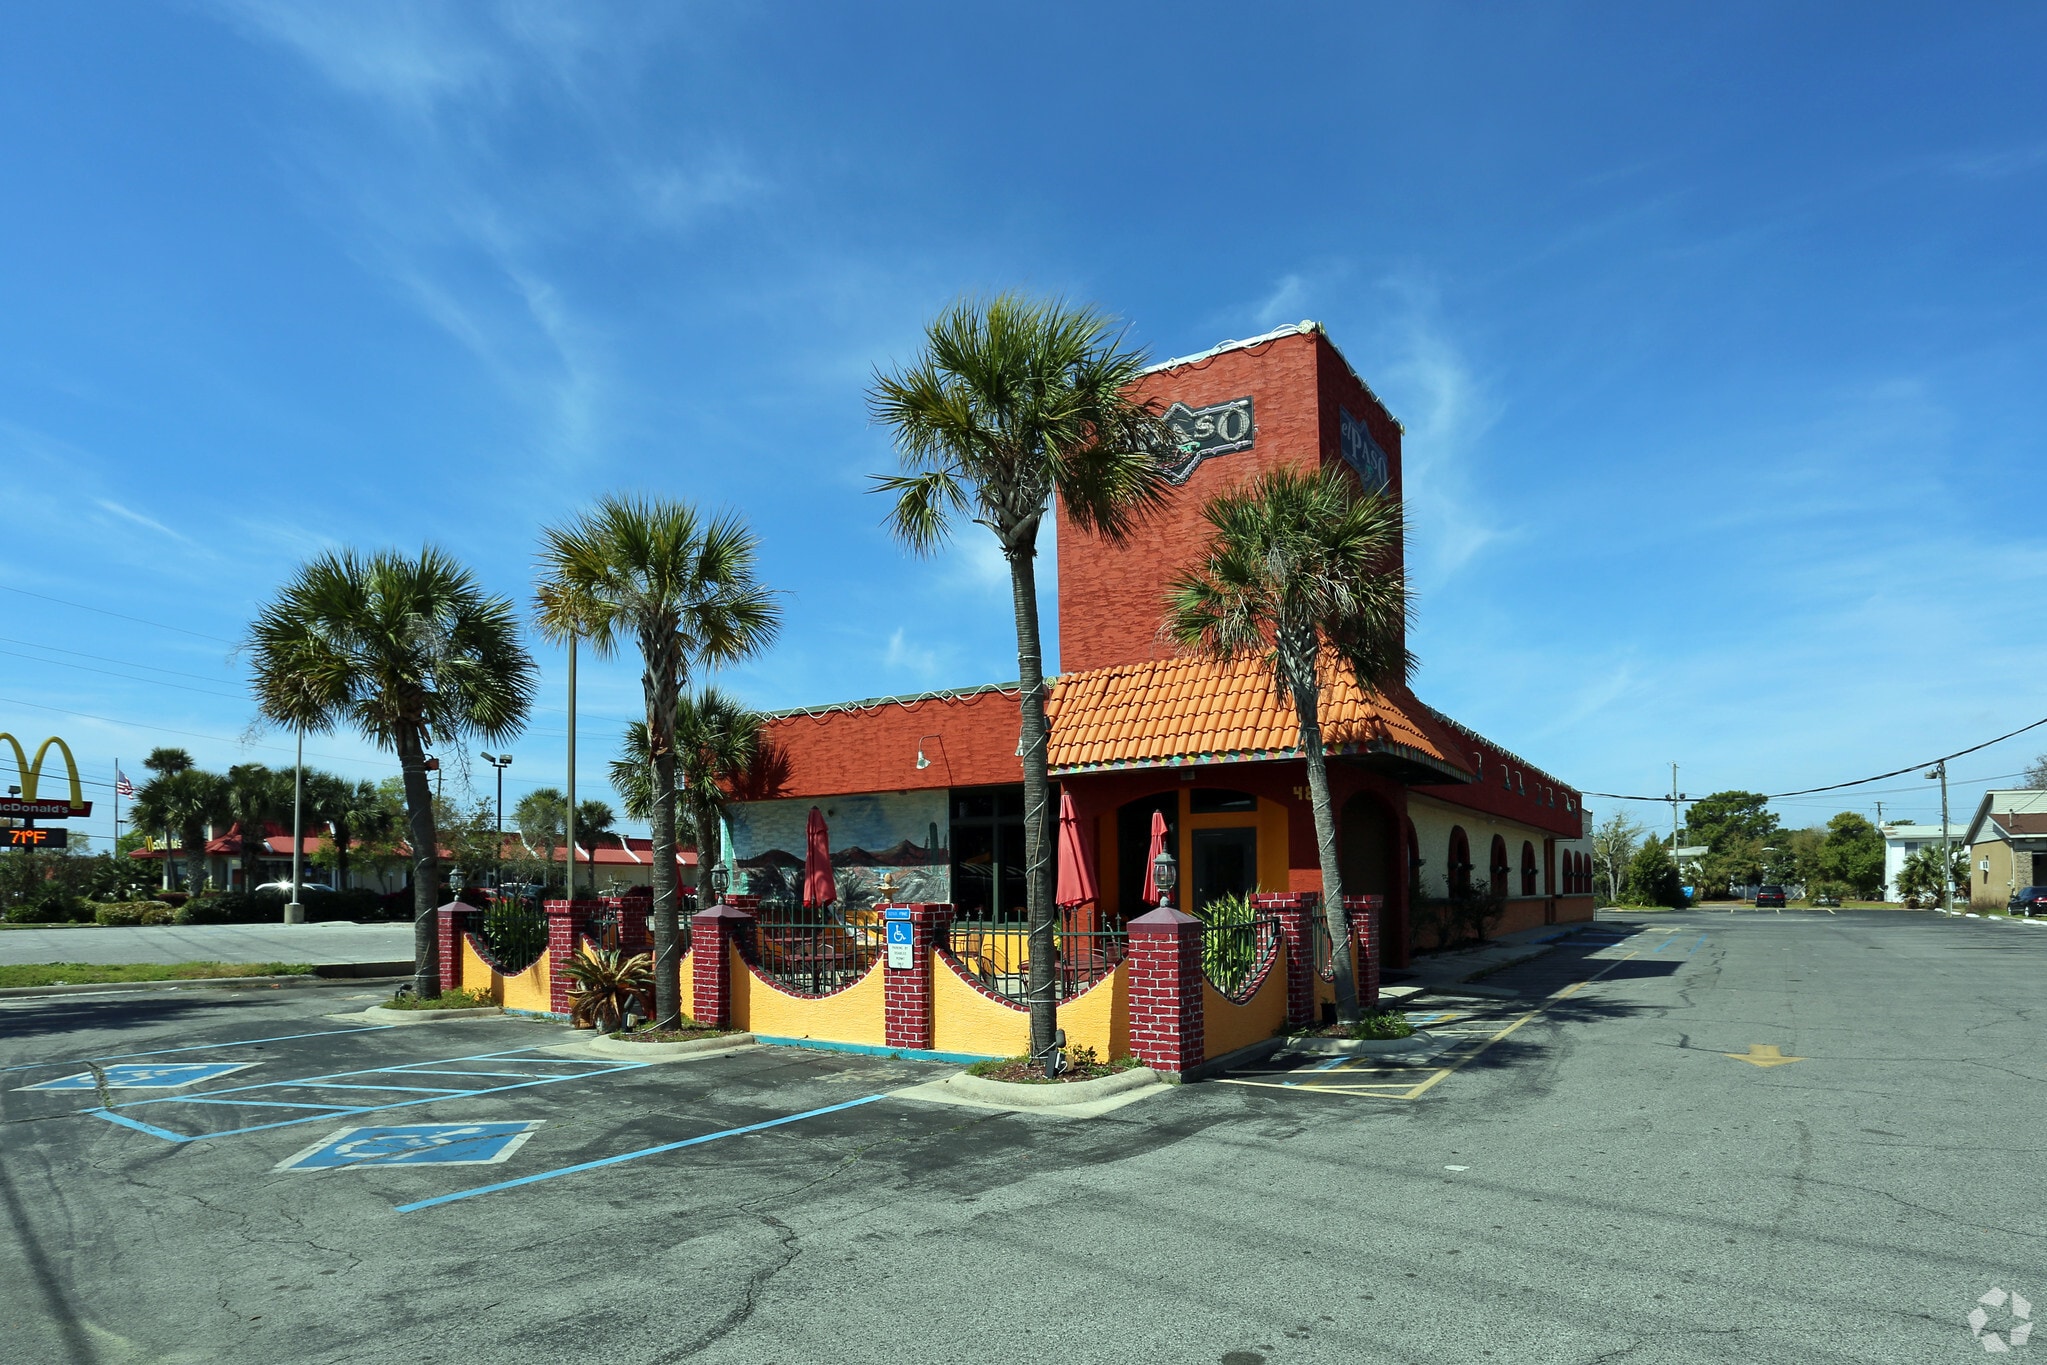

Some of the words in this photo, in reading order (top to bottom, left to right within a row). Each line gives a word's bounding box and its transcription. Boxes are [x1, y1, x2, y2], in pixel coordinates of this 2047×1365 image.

[1341, 421, 1352, 440] el
[1352, 426, 1388, 482] PASO
[0, 802, 69, 814] cDonald's
[9, 830, 47, 844] 71°F
